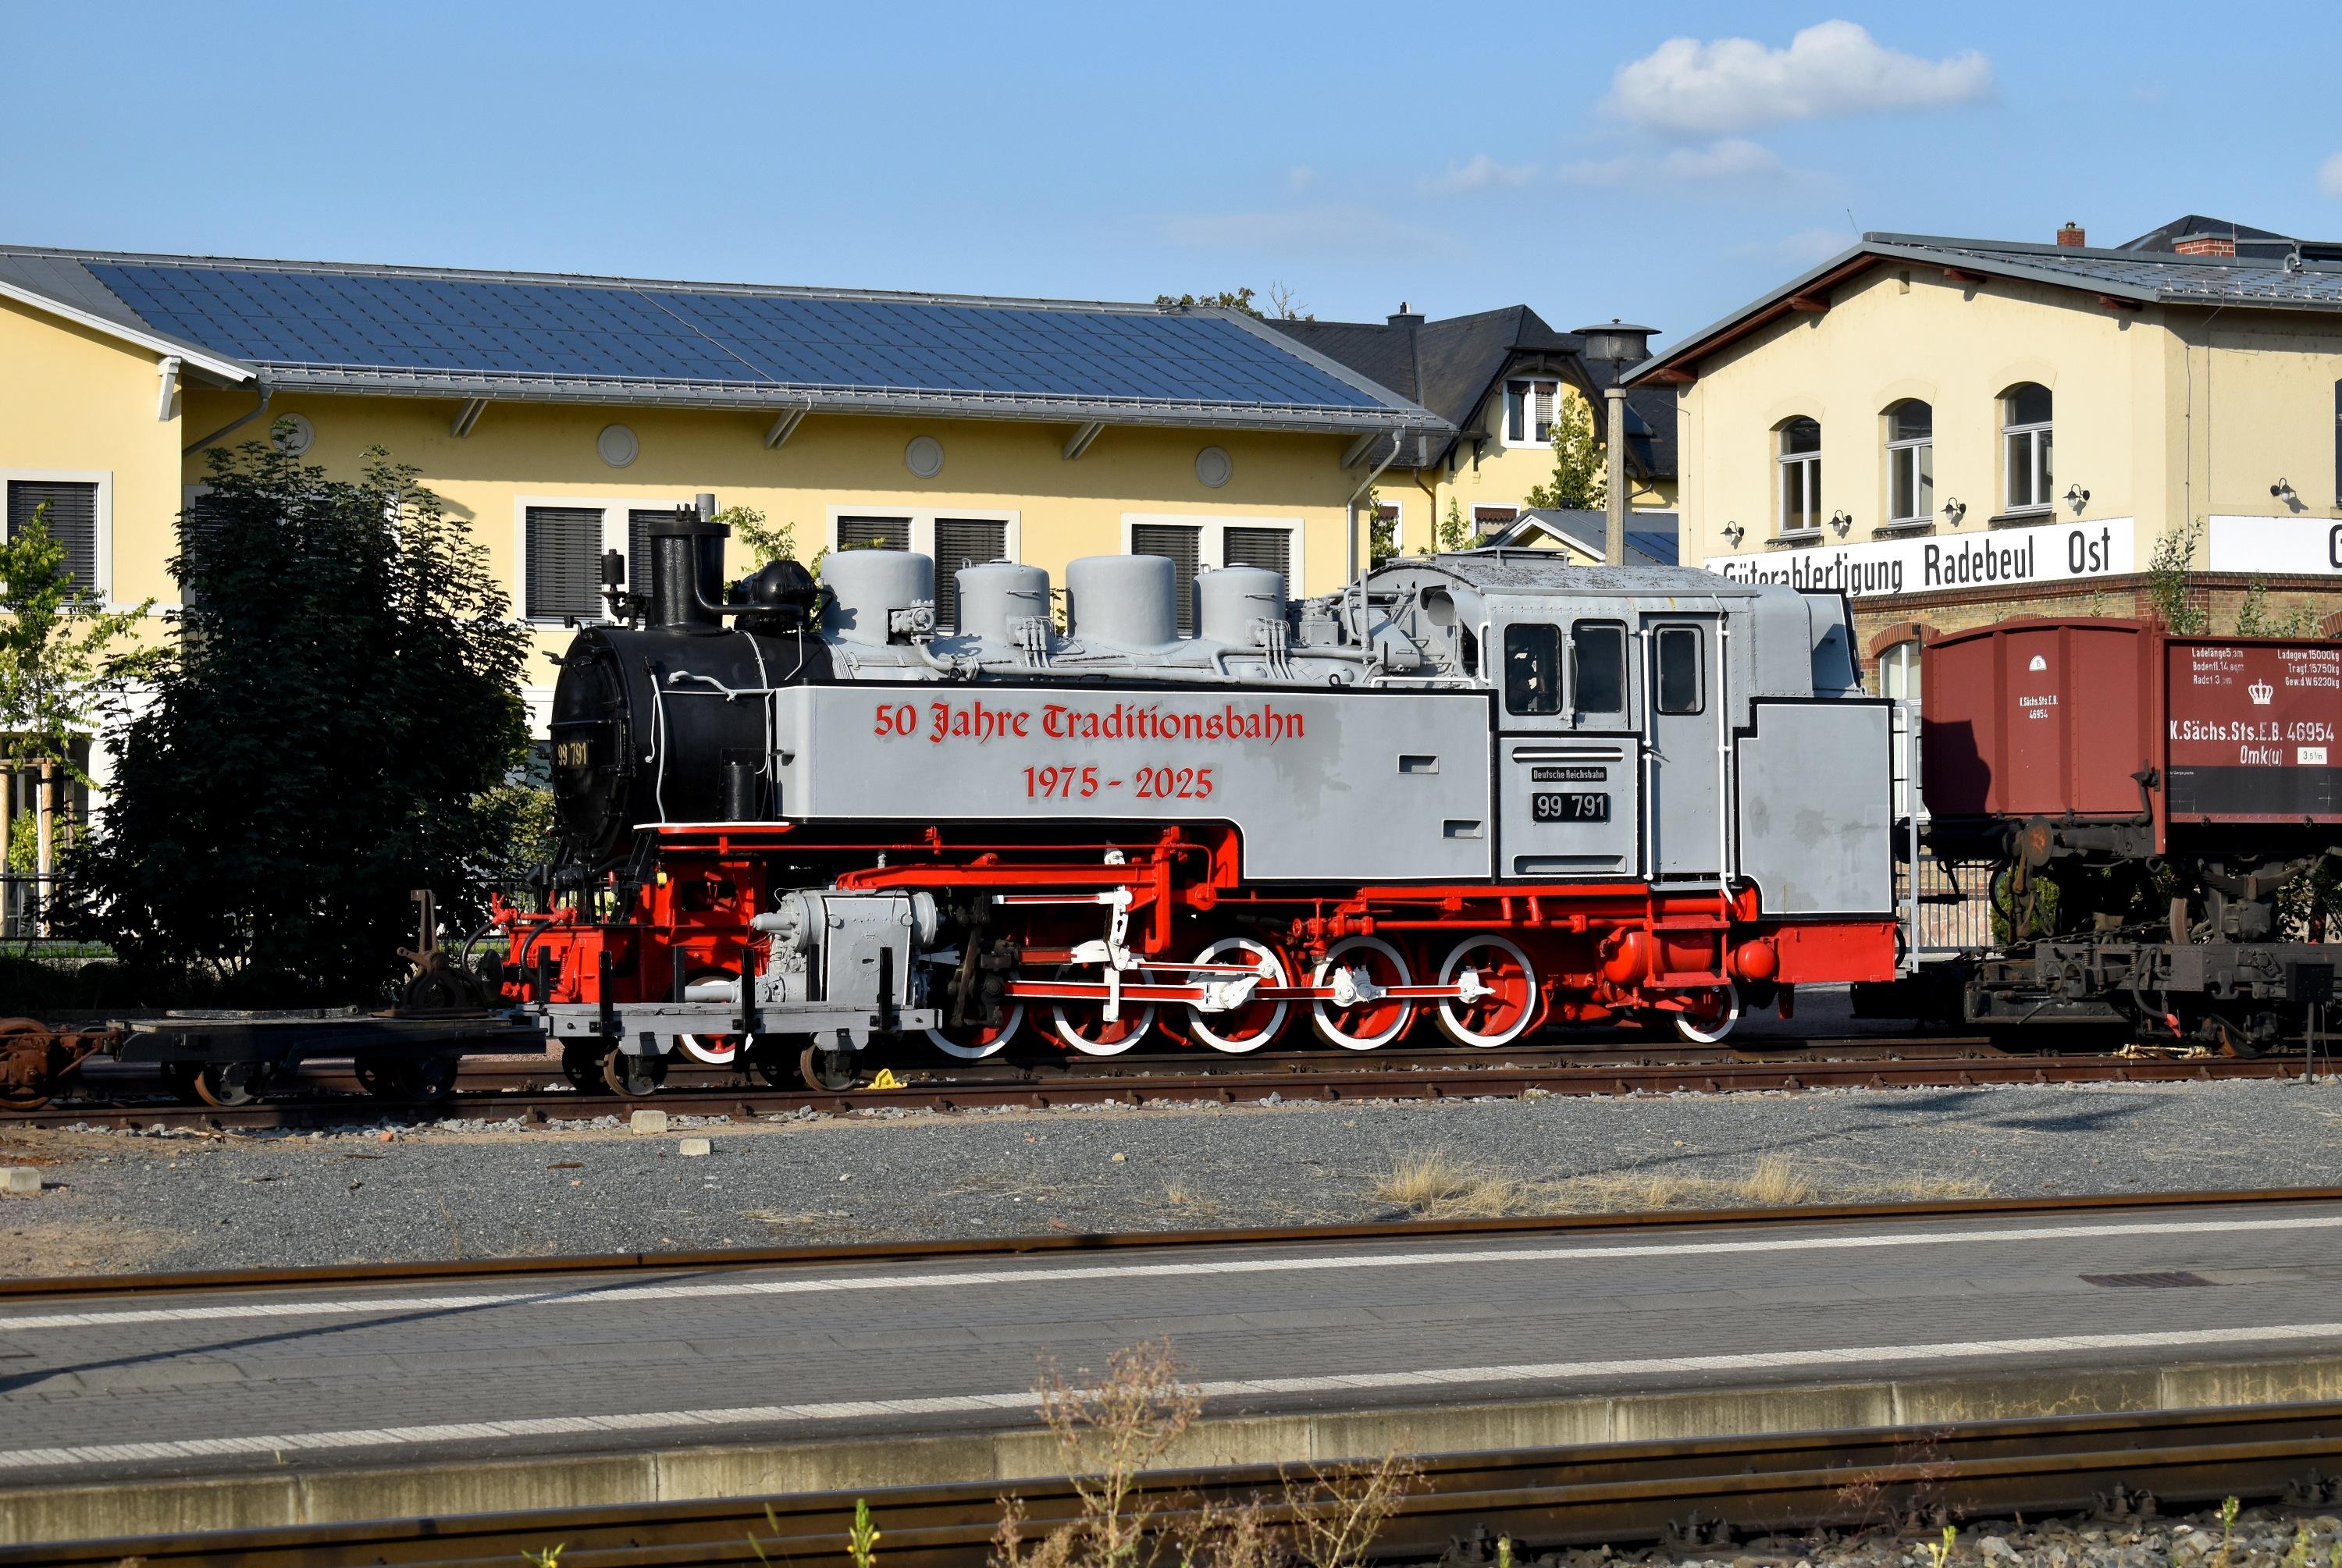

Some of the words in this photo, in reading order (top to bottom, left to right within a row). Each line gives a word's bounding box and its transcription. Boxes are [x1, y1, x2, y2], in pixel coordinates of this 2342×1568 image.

[1924, 535, 2034, 586] Radebeul
[2068, 527, 2111, 574] Ost
[874, 704, 917, 736] 50
[929, 701, 1030, 745] Jahre
[1042, 703, 1305, 747] Traditionsbahn
[2029, 709, 2048, 720] 46954
[2287, 722, 2335, 742] 46954
[557, 743, 568, 766] 99
[570, 741, 587, 766] 791
[2240, 745, 2283, 766] Omk(u)
[1023, 766, 1099, 798] 1975
[1135, 766, 1213, 798] 2025
[1533, 770, 1564, 780] Deutsche
[1566, 770, 1604, 780] Reichsbahn
[1537, 795, 1561, 817] 99
[1571, 795, 1604, 817] 791
